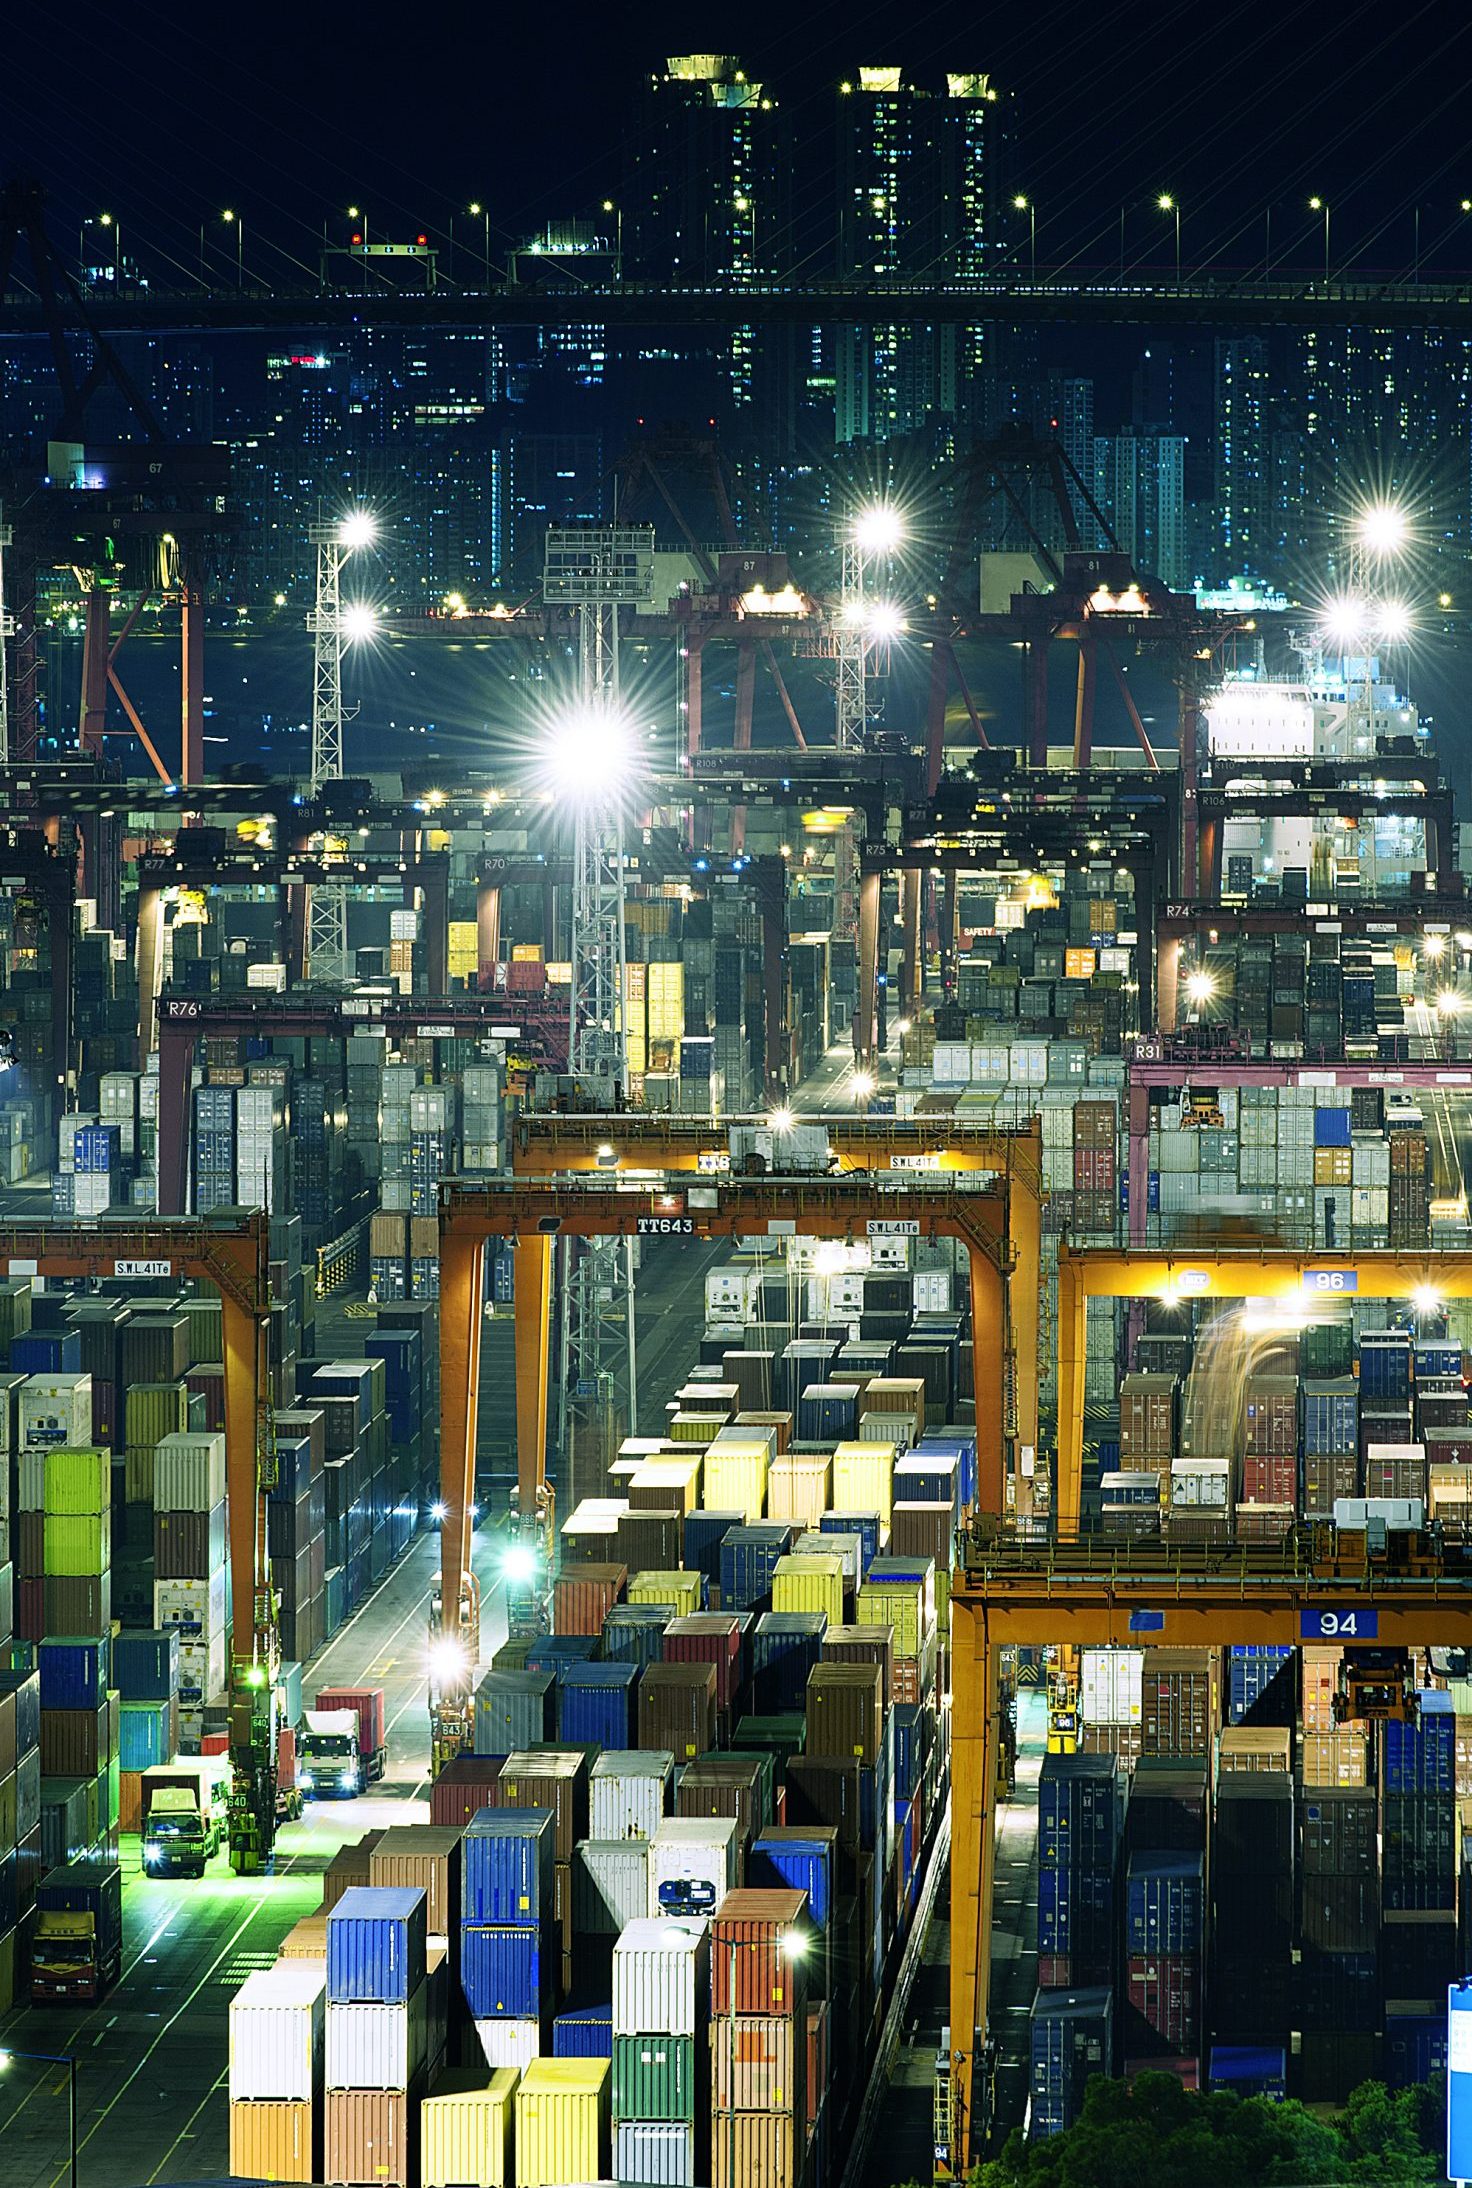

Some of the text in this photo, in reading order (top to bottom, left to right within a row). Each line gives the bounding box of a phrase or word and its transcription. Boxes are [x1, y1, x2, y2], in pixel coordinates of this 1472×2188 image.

[149, 463, 162, 474] 67
[112, 518, 121, 529] 67
[743, 561, 755, 571] 87
[1088, 560, 1100, 571] 81
[1127, 623, 1136, 634] 81
[696, 757, 717, 769] R108
[1214, 761, 1235, 770] R110
[1202, 796, 1226, 806] R106
[298, 808, 315, 819] R81
[865, 844, 886, 856] R75
[144, 859, 166, 870] R77
[485, 858, 506, 870] R70
[1166, 905, 1189, 918] R74
[963, 927, 993, 937] SAFETY
[169, 1001, 198, 1017] R76
[1136, 1045, 1161, 1059] R31
[891, 1156, 938, 1169] S.W.L.41T
[639, 1218, 693, 1235] TT643
[868, 1222, 918, 1234] S.W.L.41Te
[117, 1261, 169, 1274] S.W.L.41Te
[1315, 1273, 1345, 1289] 96
[1320, 1613, 1358, 1636] 94
[253, 1718, 267, 1727] 640
[1059, 1719, 1071, 1727] 96
[443, 1726, 461, 1736] 643
[228, 1796, 247, 1808] 640
[935, 2147, 948, 2159] 94
